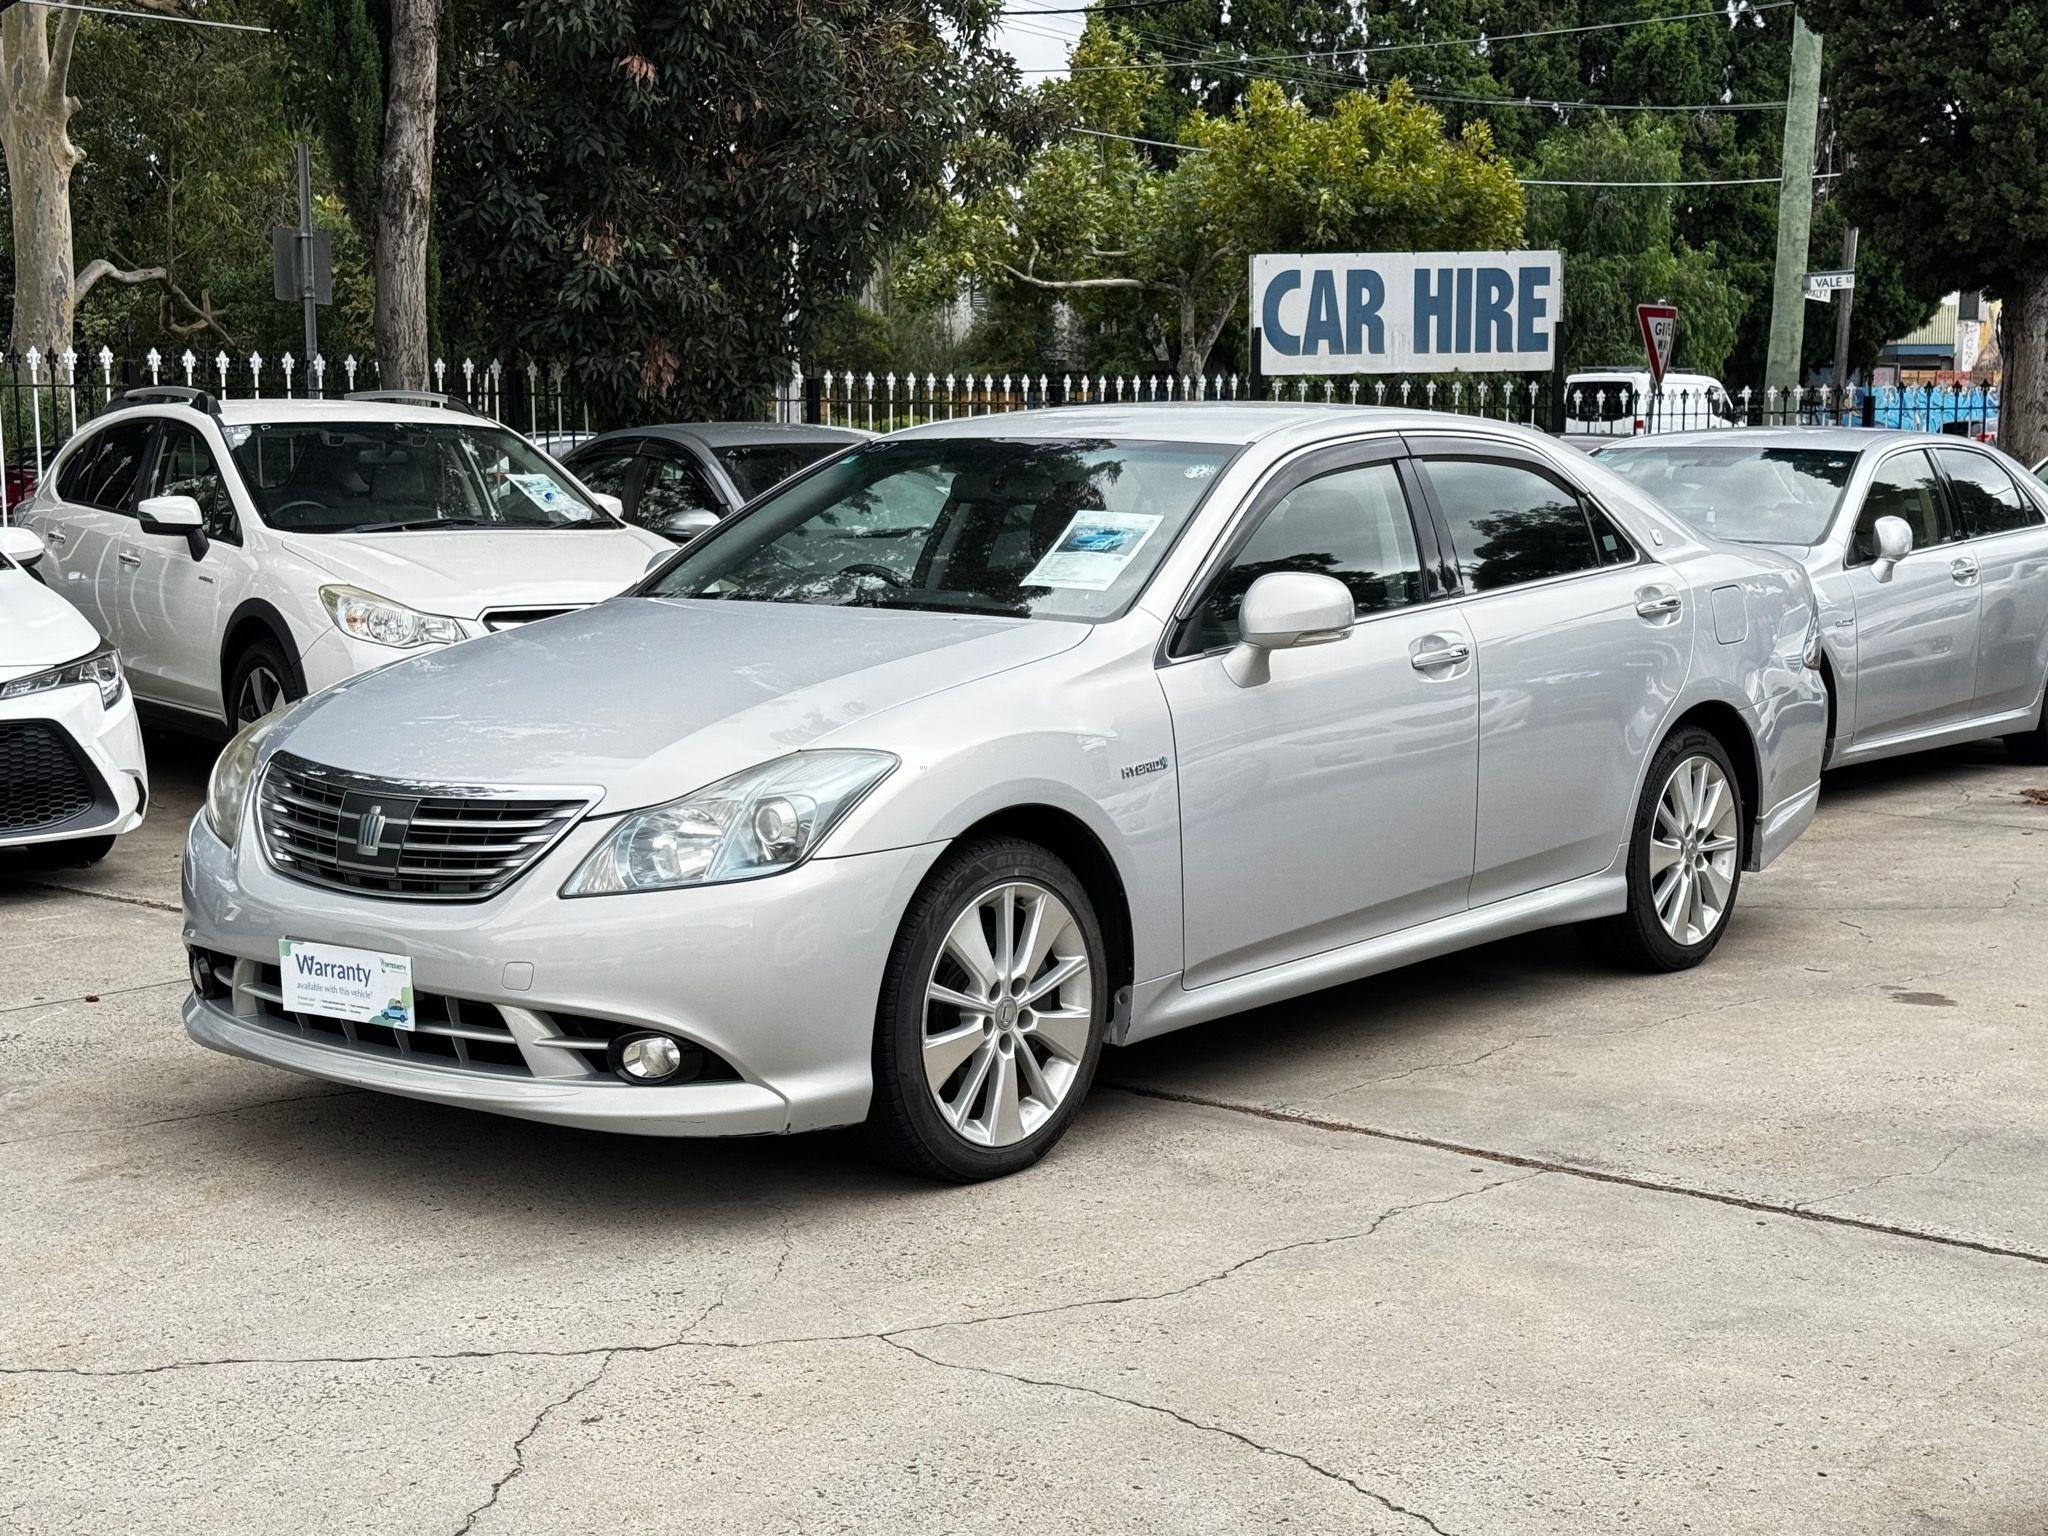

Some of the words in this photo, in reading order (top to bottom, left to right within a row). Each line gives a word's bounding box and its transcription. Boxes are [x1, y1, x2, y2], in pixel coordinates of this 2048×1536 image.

[1815, 277, 1843, 288] VALE
[1262, 269, 1385, 356] CAR
[1414, 267, 1551, 354] HIRE
[1121, 760, 1162, 779] HYBRID
[295, 953, 371, 987] Warranty
[297, 982, 324, 993] available
[324, 985, 338, 994] with
[339, 986, 350, 996] this
